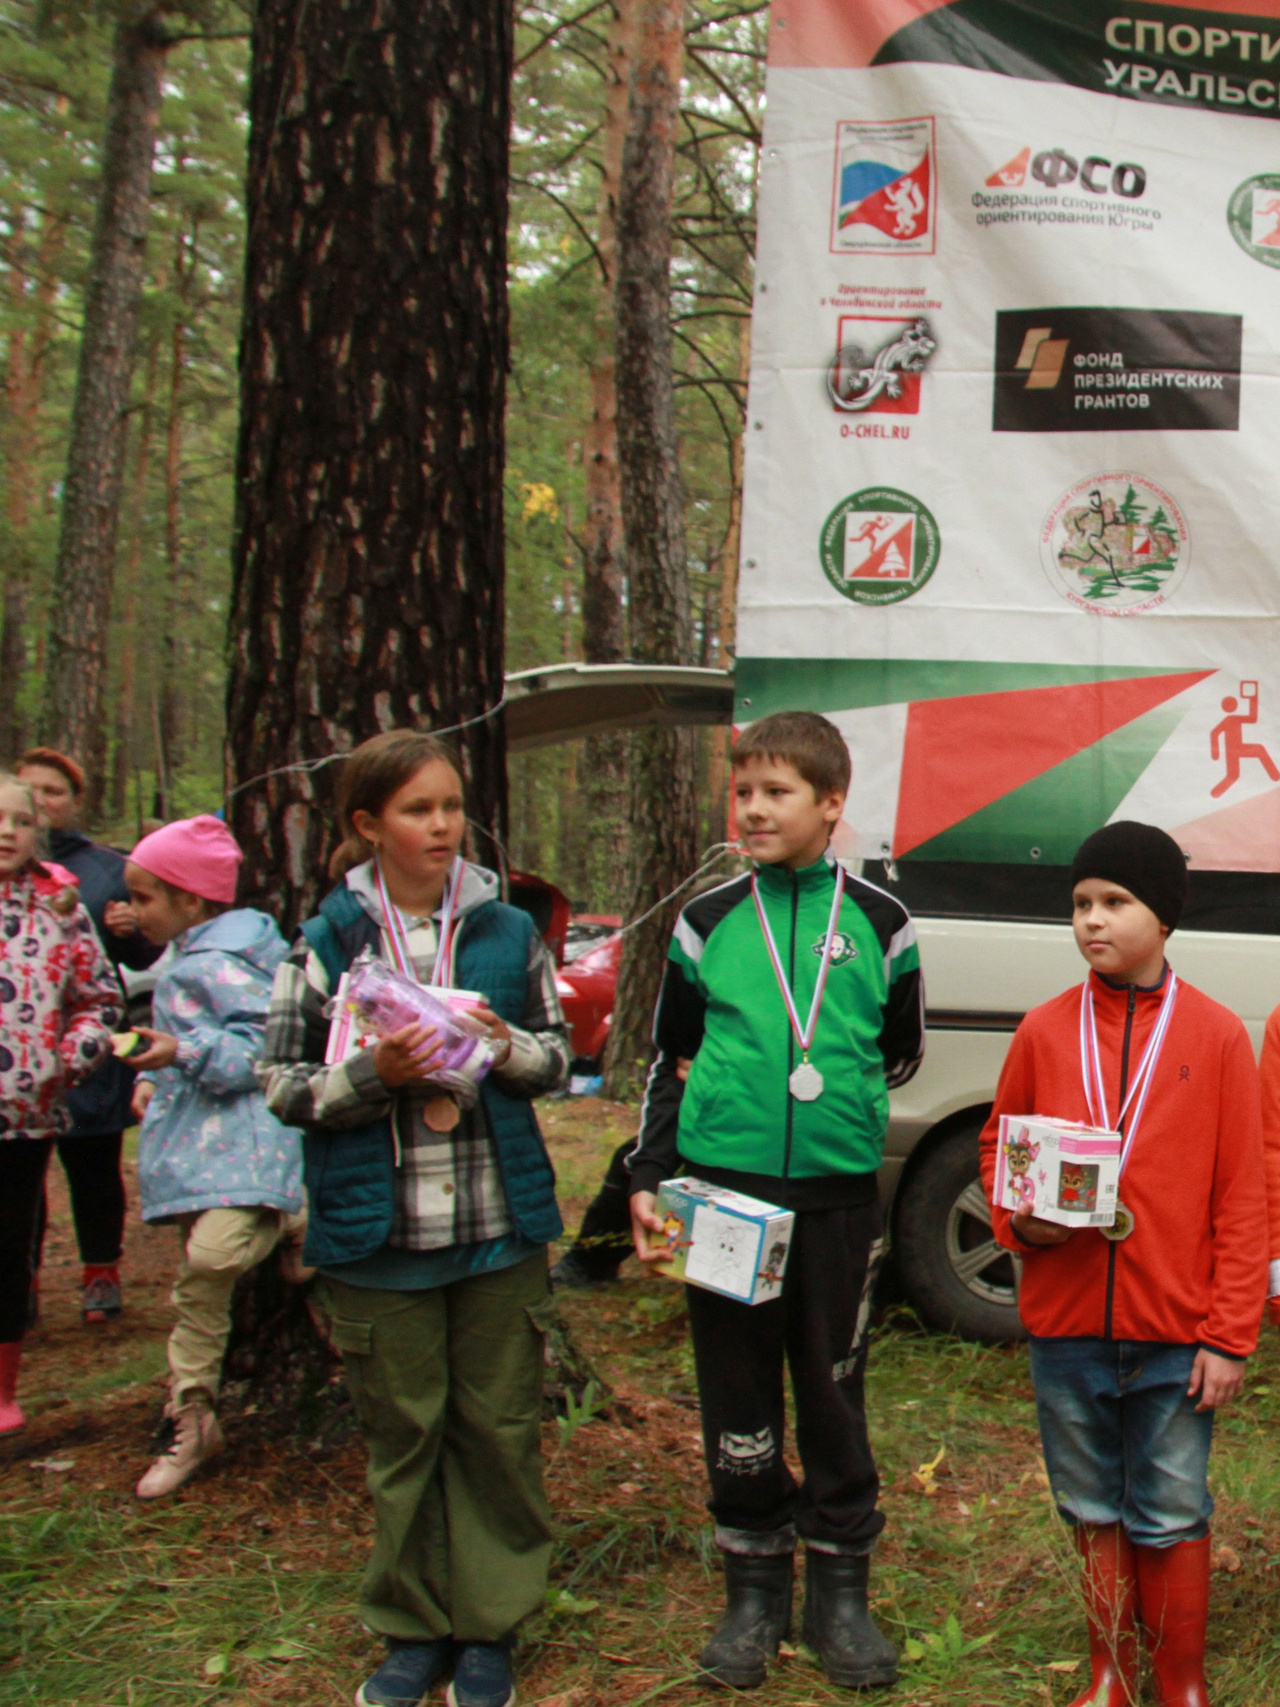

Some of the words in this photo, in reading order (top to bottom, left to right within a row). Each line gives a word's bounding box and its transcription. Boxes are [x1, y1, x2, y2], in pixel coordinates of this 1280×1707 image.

[1031, 147, 1147, 198] ФСО
[971, 191, 1058, 209] Федерация
[1061, 196, 1162, 220] спортивного
[976, 208, 1104, 226] ориентирования
[1108, 213, 1154, 231] Югры
[1073, 352, 1124, 368] ФОНД
[1074, 373, 1223, 390] ПРЕЗИДЕНТСКИХ
[1074, 393, 1151, 410] ГРАНТОВ
[840, 424, 910, 439] O-CHEL.RU
